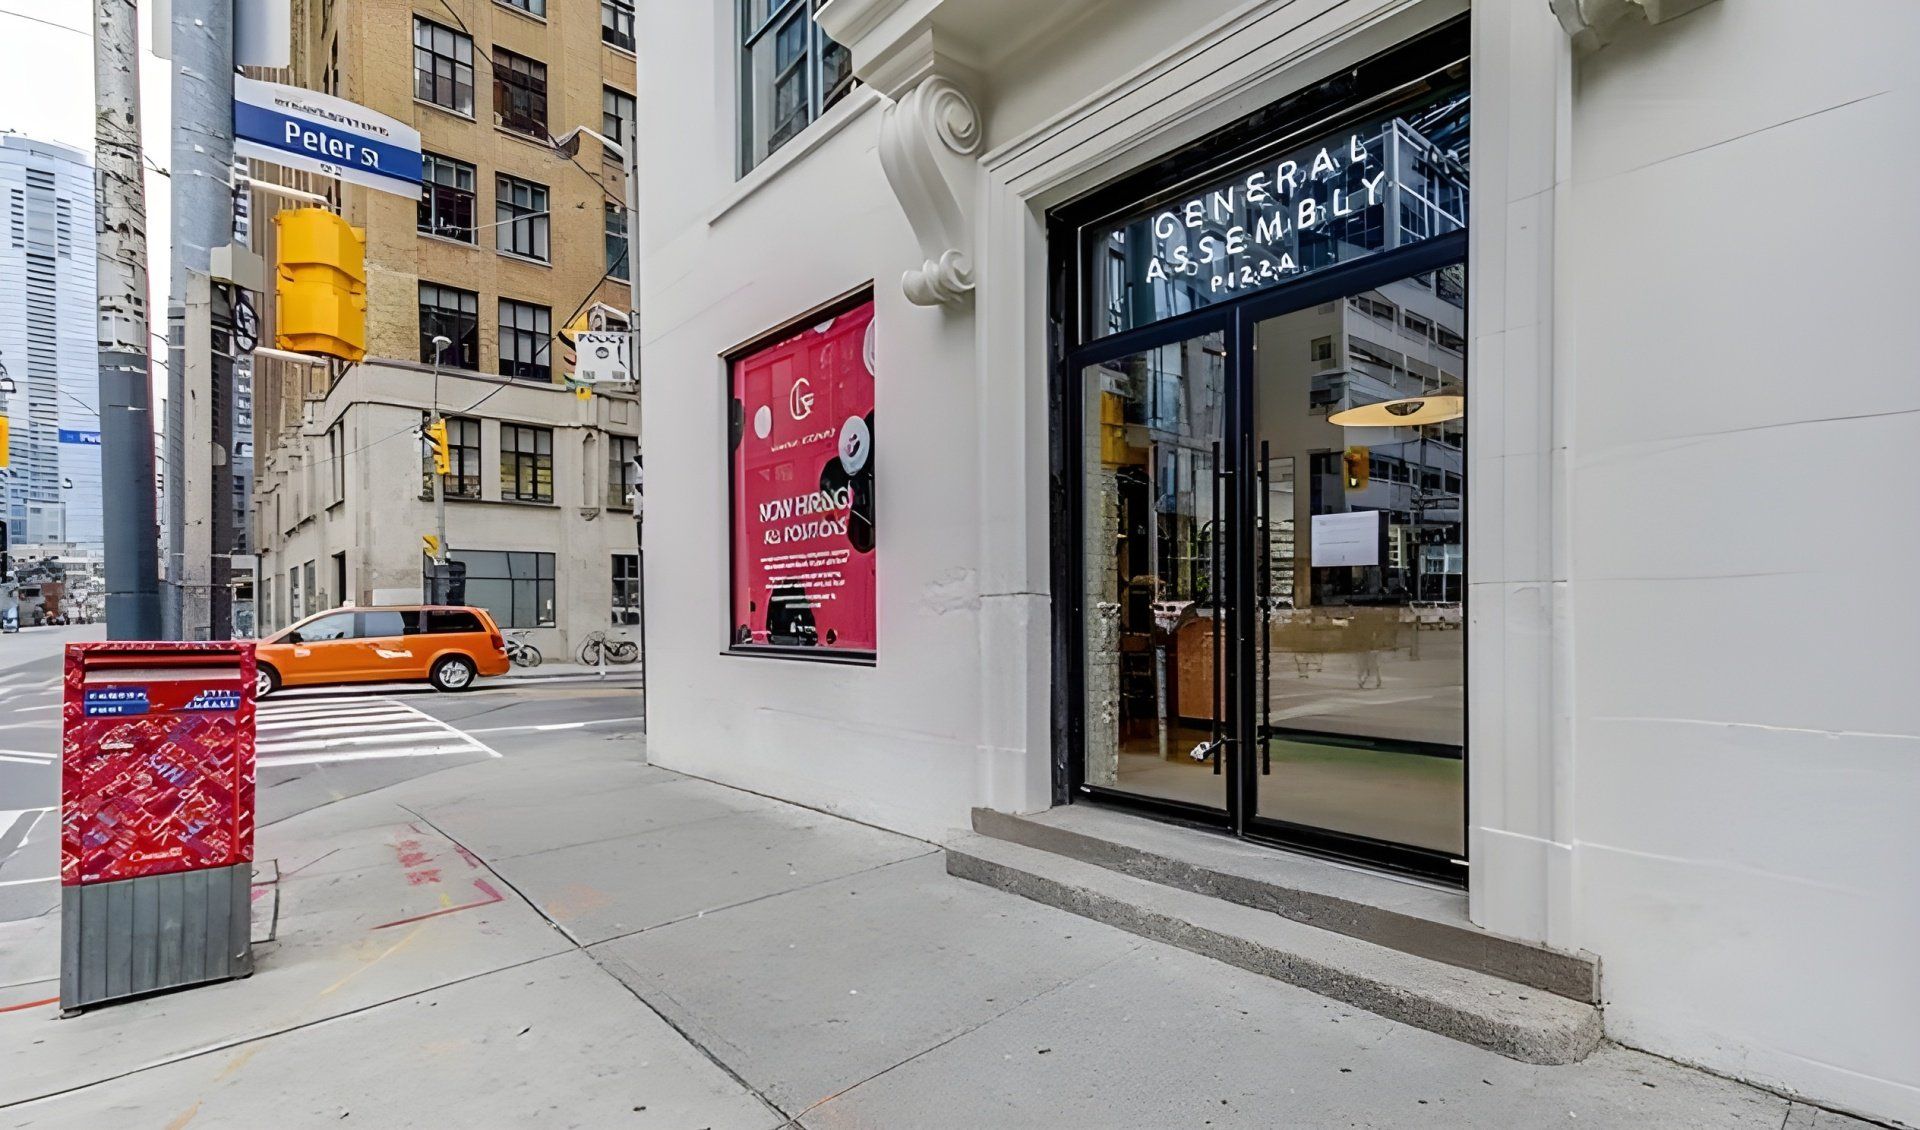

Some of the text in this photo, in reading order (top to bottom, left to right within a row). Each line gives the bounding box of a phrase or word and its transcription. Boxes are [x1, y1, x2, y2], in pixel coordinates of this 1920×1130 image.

[285, 120, 354, 161] Peter
[1155, 135, 1368, 239] GENERAL
[1146, 171, 1385, 283] ASSEMBLY
[1211, 252, 1296, 293] PIZZA
